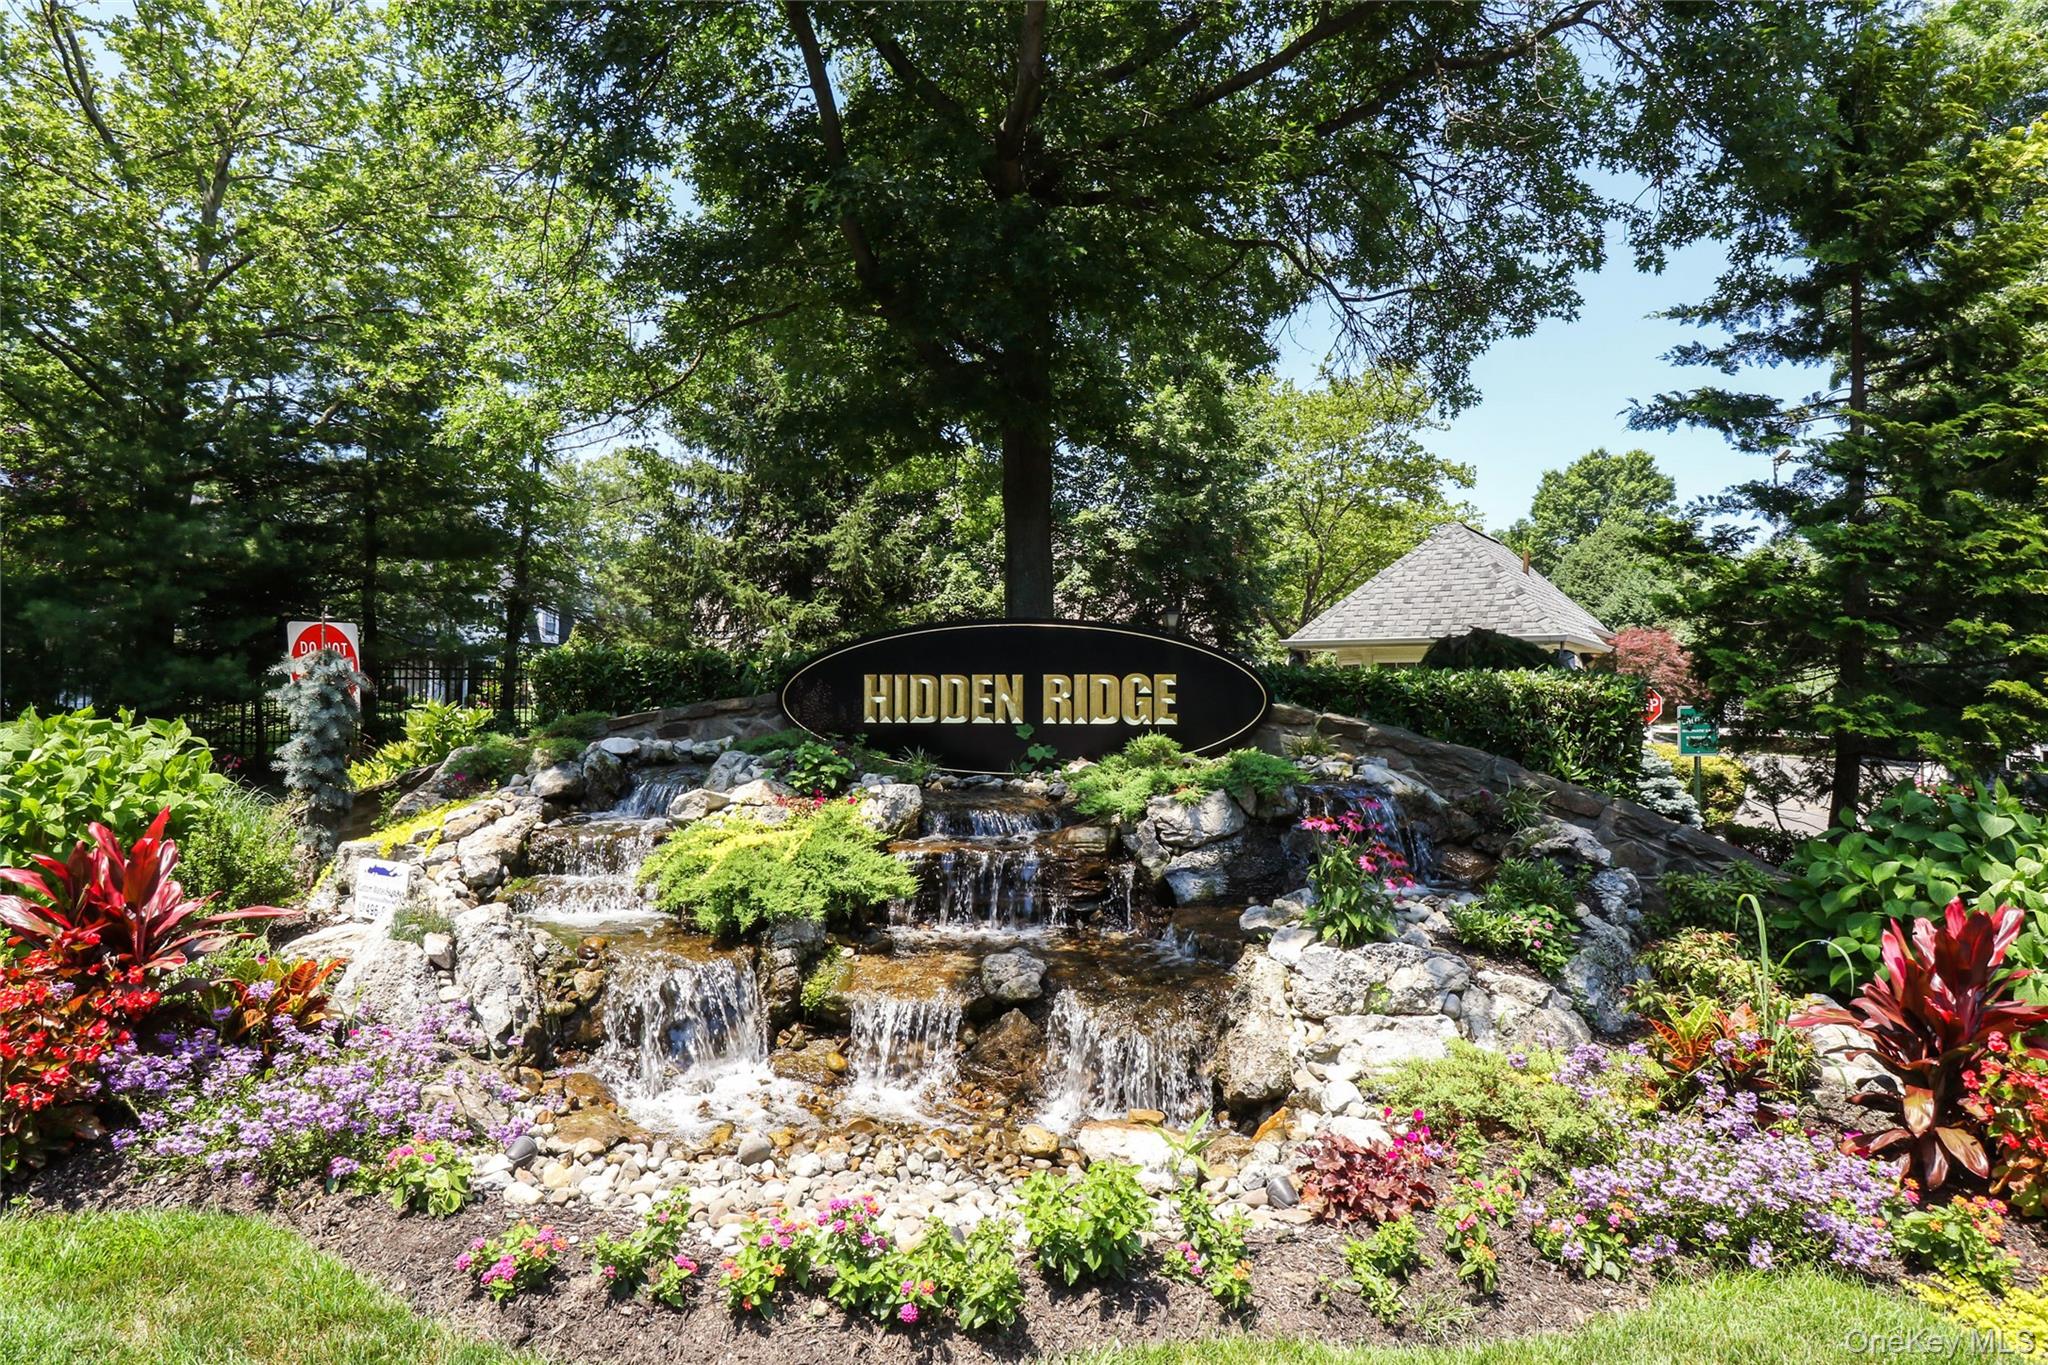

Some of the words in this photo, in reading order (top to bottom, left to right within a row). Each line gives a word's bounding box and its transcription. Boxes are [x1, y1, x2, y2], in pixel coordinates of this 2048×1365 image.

[300, 641, 316, 654] DO
[863, 673, 1024, 725] HIDDEN
[1043, 672, 1179, 726] RIDGE
